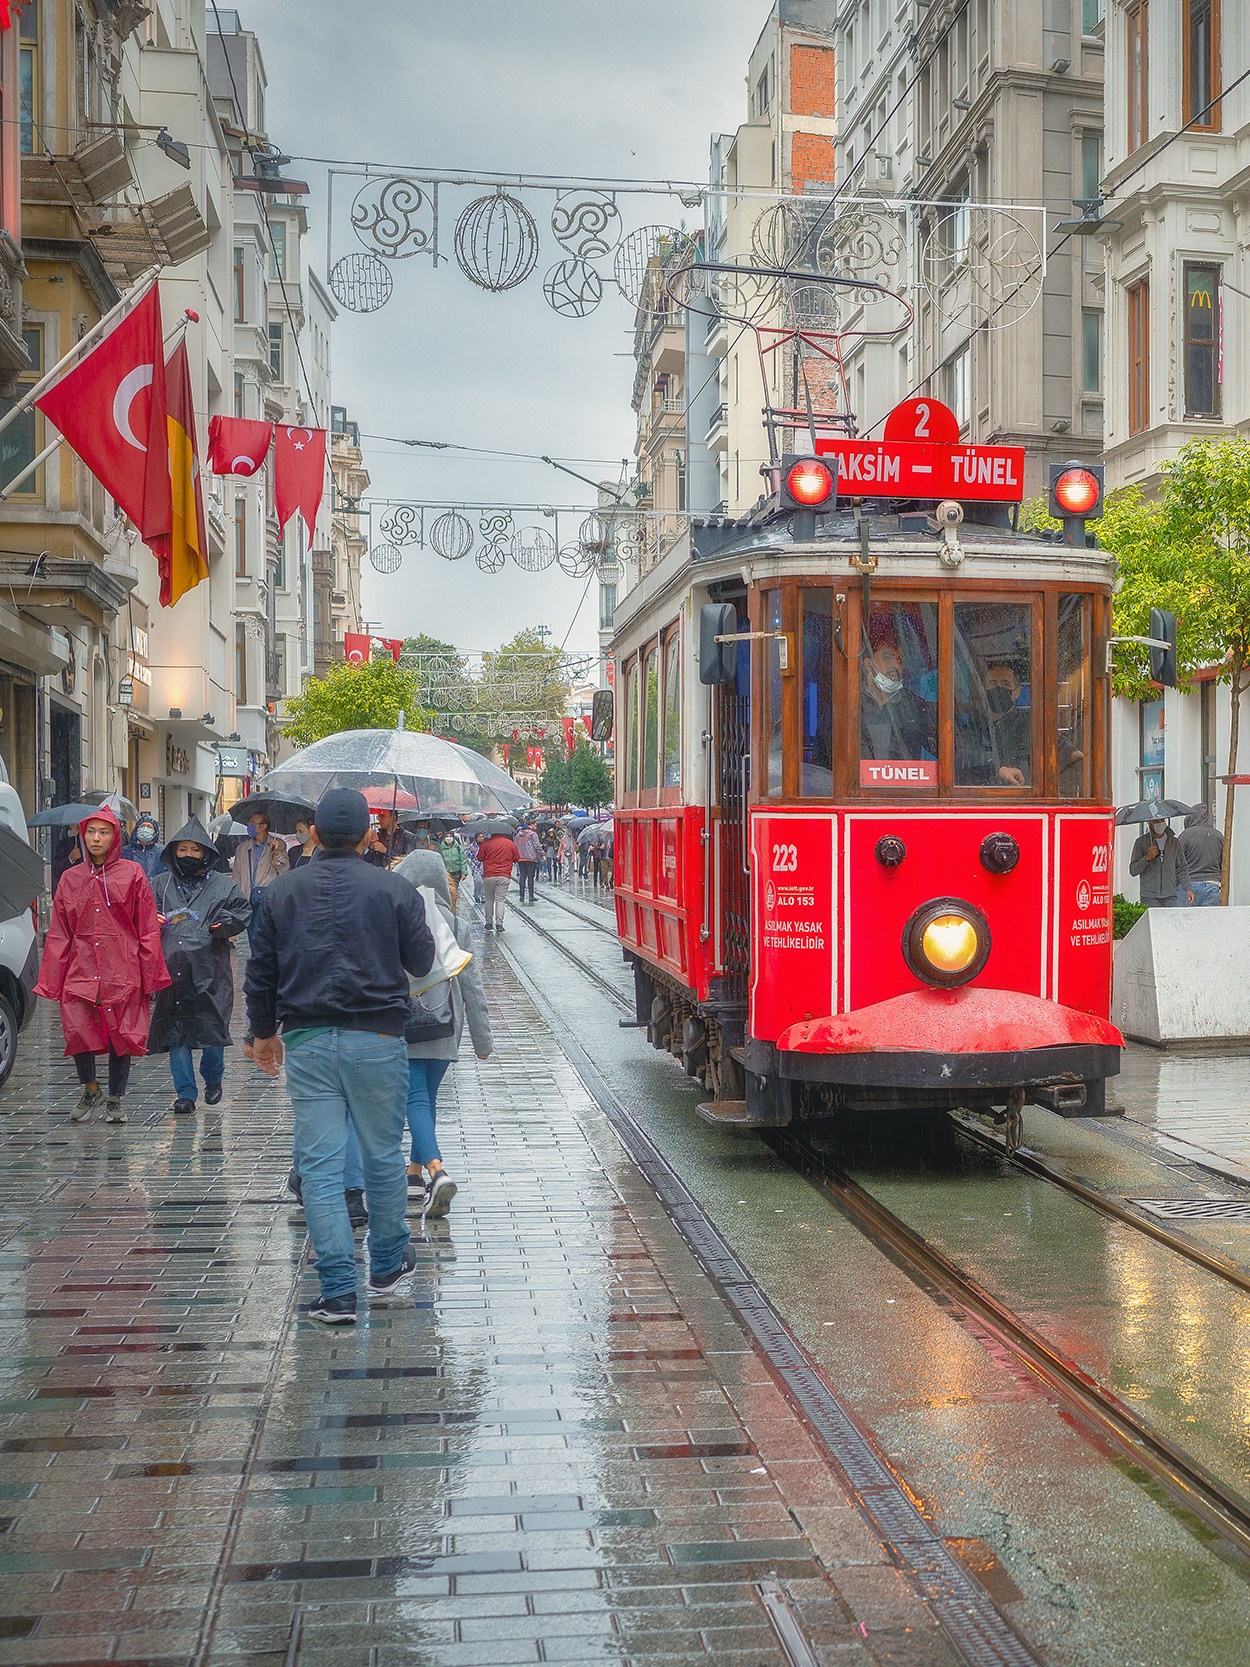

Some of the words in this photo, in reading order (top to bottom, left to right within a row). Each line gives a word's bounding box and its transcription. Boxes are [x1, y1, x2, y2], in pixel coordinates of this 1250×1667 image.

[914, 403, 931, 437] 2
[822, 447, 900, 483] AKSİM
[951, 449, 1017, 486] TÜNEL
[869, 765, 930, 780] TÜNEL
[772, 844, 797, 872] 223
[1092, 846, 1108, 873] 223
[777, 897, 795, 906] ALO
[797, 897, 815, 906] 153
[1092, 896, 1102, 905] ALO
[764, 920, 793, 932] ASILMAK
[794, 921, 823, 933] YASAK
[1072, 918, 1100, 930] ASILMAK
[763, 936, 770, 947] VE
[770, 935, 824, 950] TEHLİKELİDİR
[1070, 935, 1081, 946] VE
